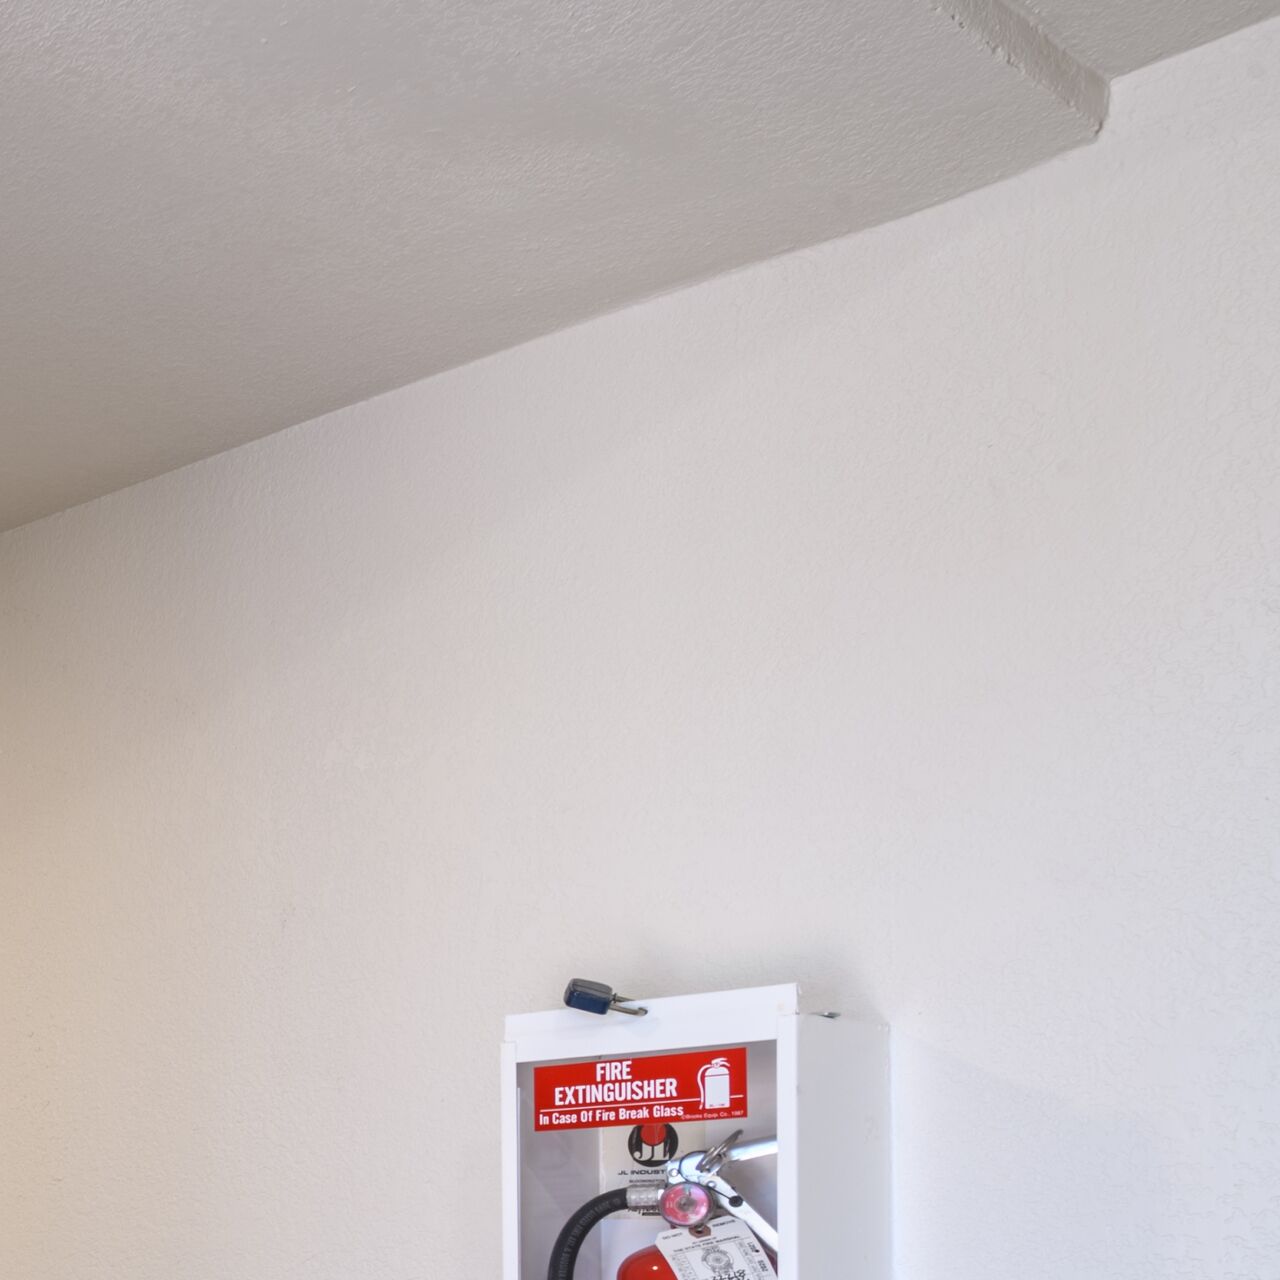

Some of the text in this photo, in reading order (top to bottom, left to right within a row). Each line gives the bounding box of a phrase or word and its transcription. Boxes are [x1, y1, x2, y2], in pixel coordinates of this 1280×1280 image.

[596, 1061, 632, 1082] FIRE
[554, 1078, 678, 1106] EXTINGUISHER
[540, 1105, 684, 1125] In Case Of Fire Break Glass
